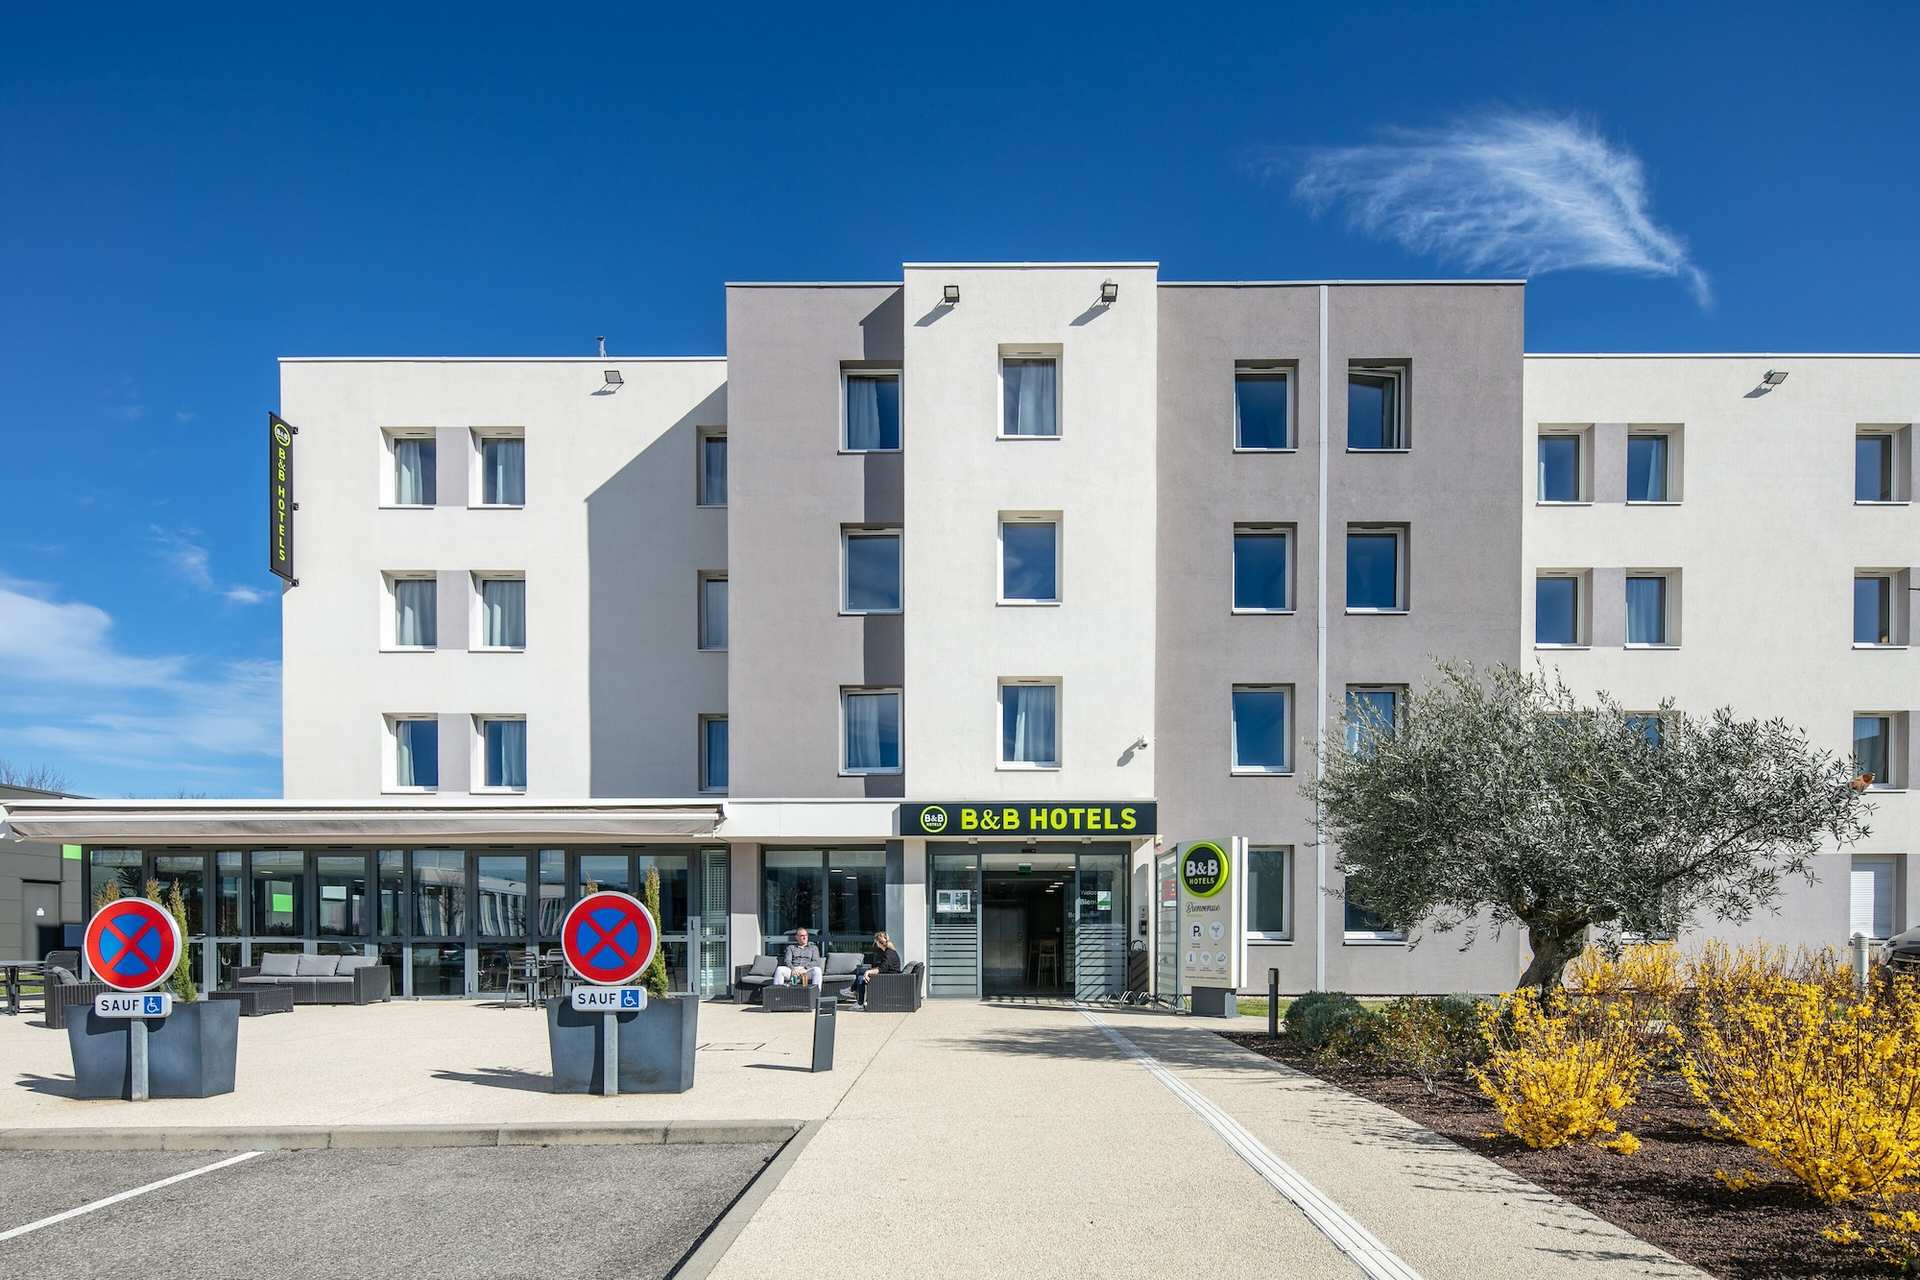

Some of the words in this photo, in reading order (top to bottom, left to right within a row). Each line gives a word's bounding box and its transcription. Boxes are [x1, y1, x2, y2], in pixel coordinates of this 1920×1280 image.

[278, 447, 286, 482] B&B
[278, 485, 286, 561] HOTELS
[924, 813, 944, 823] B&B
[961, 808, 1020, 830] B&B
[1030, 808, 1137, 830] HOTELS
[1186, 859, 1219, 877] B&B
[1189, 877, 1215, 885] HOTELS
[101, 999, 140, 1011] SAUF
[578, 993, 617, 1004] SAUF
